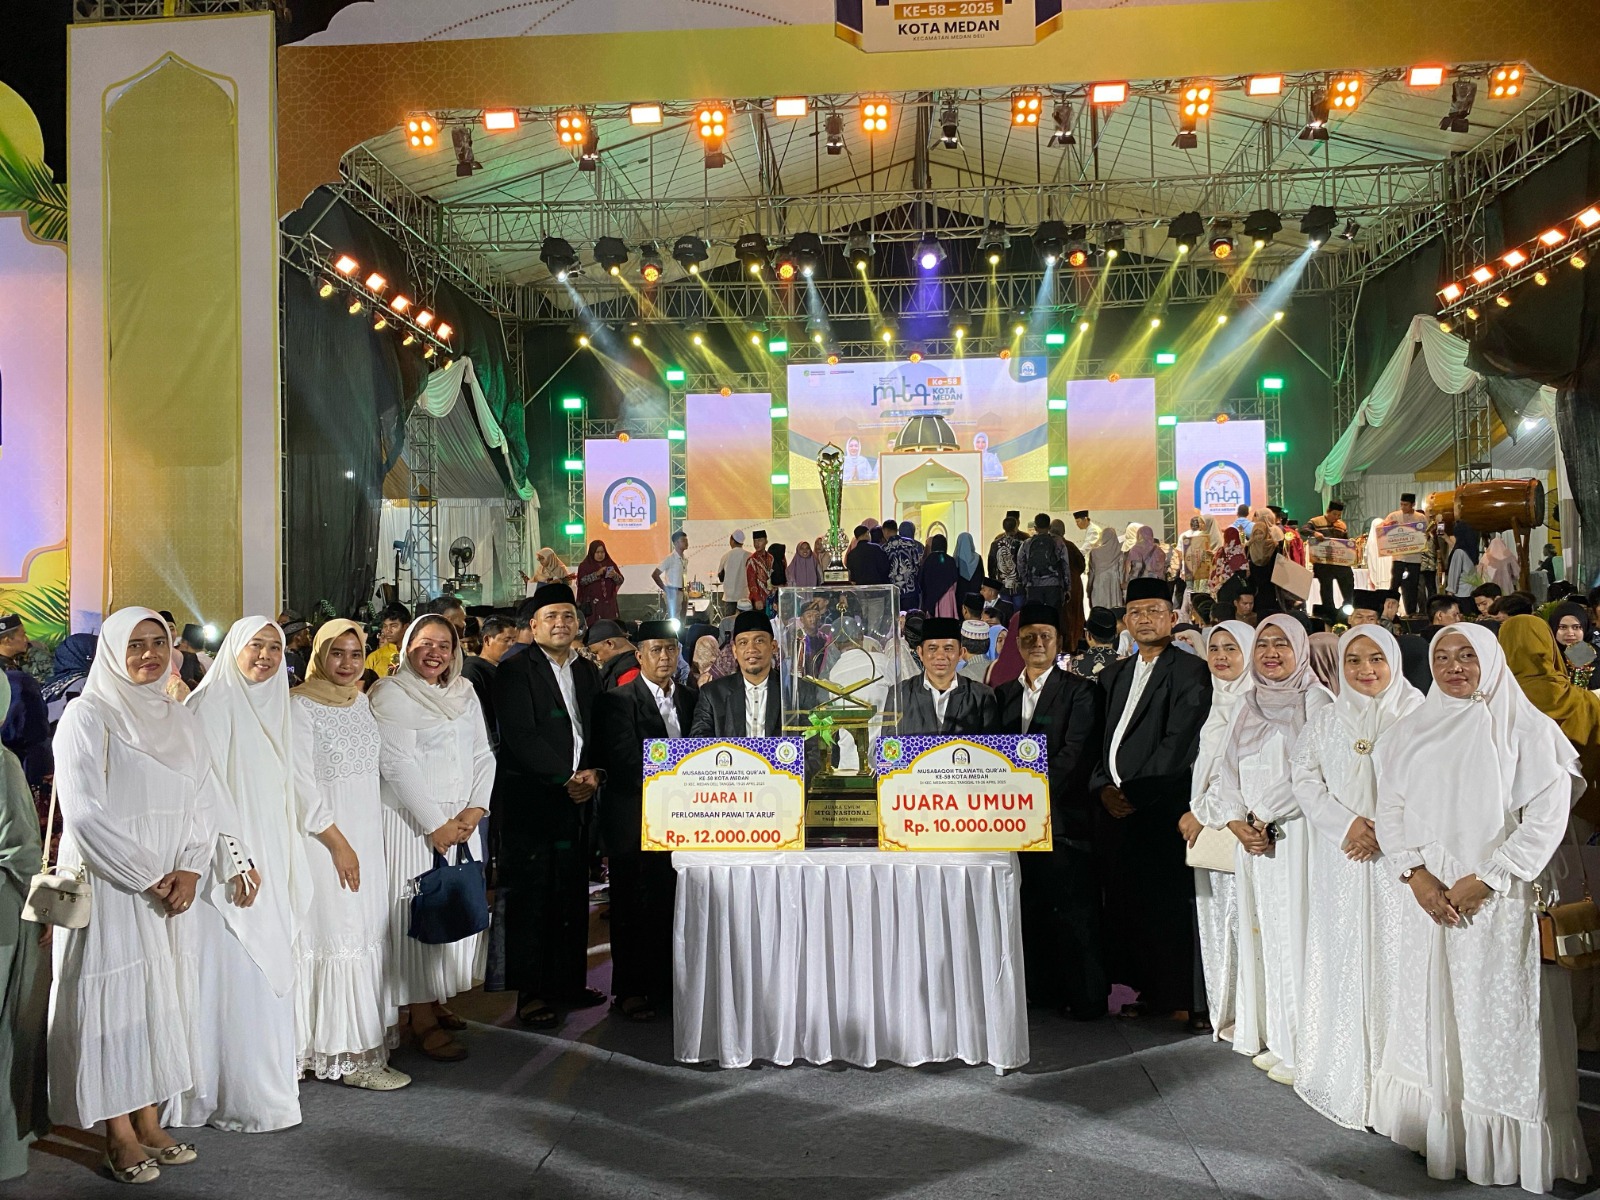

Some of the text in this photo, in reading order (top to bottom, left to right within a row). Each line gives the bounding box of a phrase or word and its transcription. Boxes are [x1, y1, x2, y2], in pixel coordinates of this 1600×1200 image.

[902, 4, 945, 17] KE-58
[961, 3, 995, 15] 2025
[898, 19, 1000, 35] KOTA MEDAN
[932, 378, 958, 386] Ke-58
[692, 792, 753, 803] JUARA II
[892, 793, 1033, 811] JUARA UMUM
[904, 818, 1026, 836] Rp. 10.000.000
[666, 829, 781, 846] Rp. 12.000.000
